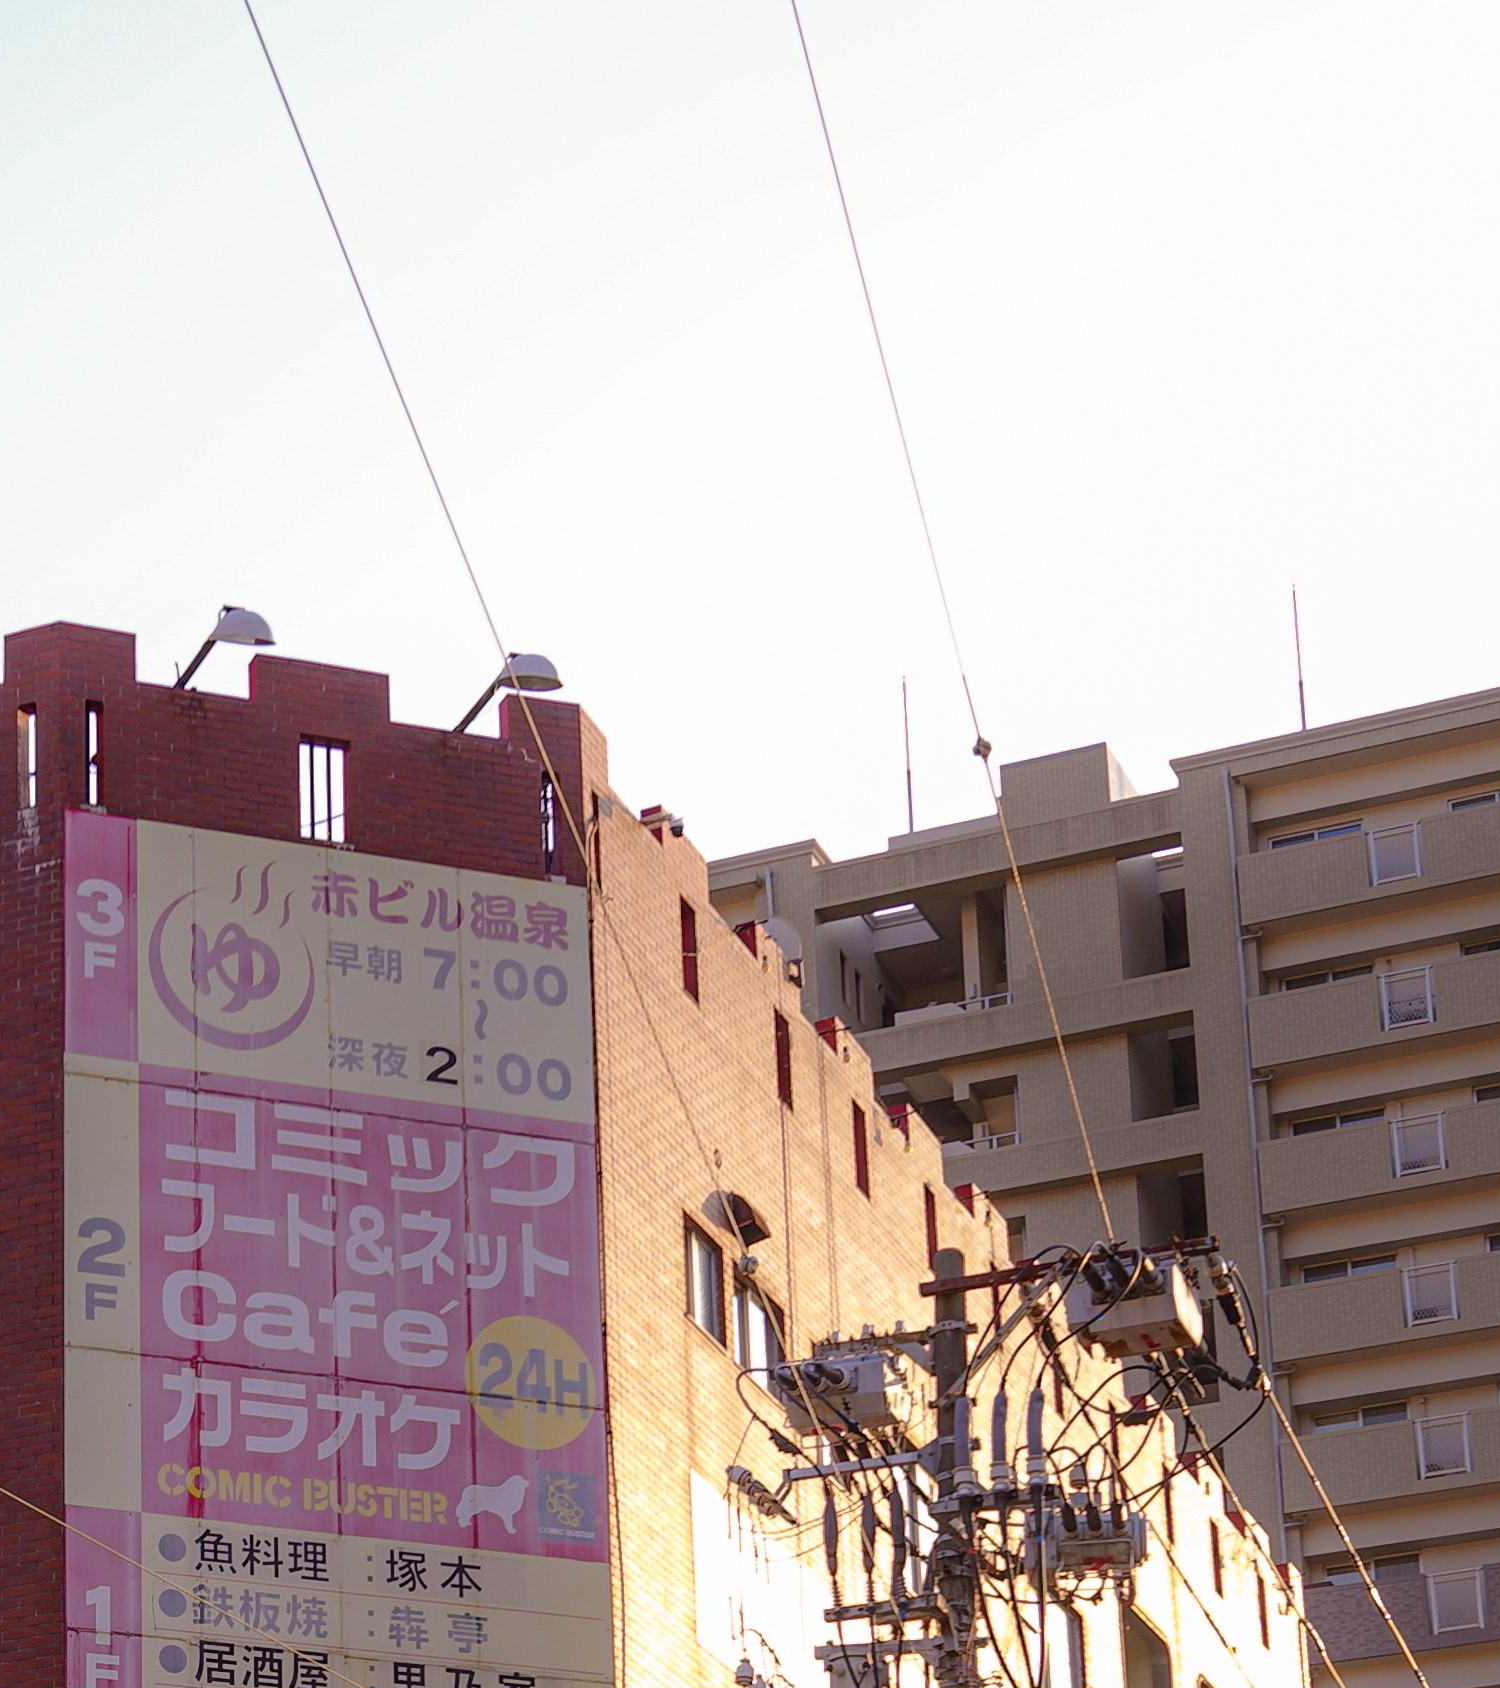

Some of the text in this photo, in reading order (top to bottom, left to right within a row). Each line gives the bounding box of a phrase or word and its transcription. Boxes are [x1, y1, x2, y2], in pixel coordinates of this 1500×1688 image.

[309, 870, 570, 951] 赤ビル温泉
[189, 921, 282, 1014] ゆ
[326, 942, 569, 1007] 早朝 7:00
[327, 1036, 573, 1101] 深夜 2:00
[164, 1090, 577, 1208] コミック
[477, 1341, 590, 1420] 24H
[161, 1367, 461, 1470] カラオケ
[157, 1463, 449, 1525] COMIC BUSTER
[194, 1528, 330, 1583] 魚料理
[191, 1583, 330, 1639] 鉄板焼
